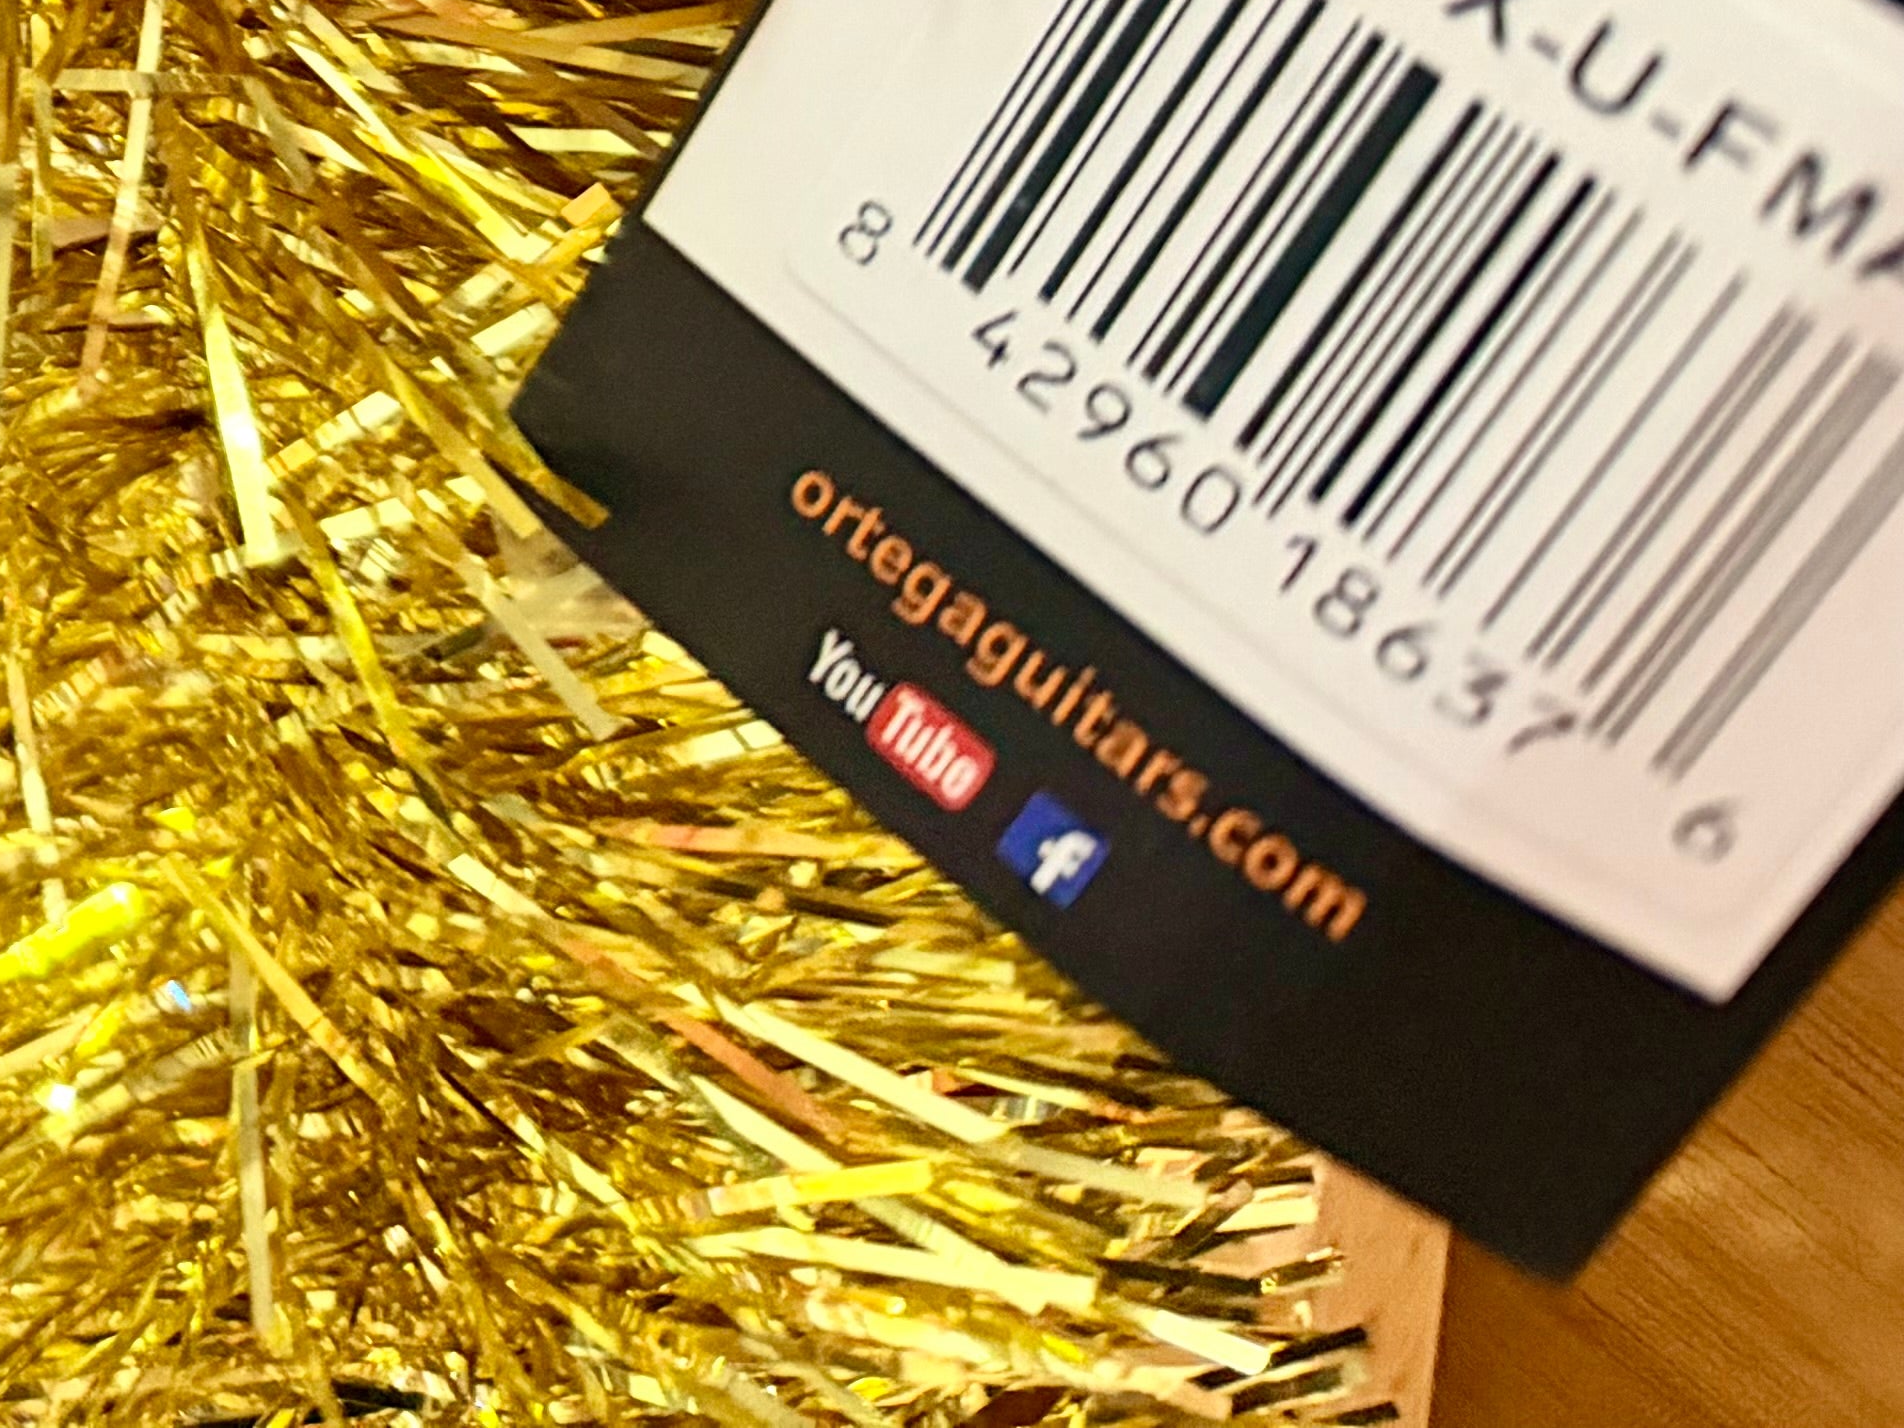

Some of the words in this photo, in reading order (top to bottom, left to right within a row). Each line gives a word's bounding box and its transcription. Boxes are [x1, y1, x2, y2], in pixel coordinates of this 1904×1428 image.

[791, 469, 1367, 942] ortegaguitars.com
[837, 200, 893, 266] 8
[970, 310, 1242, 535] 42960
[1280, 534, 1578, 758] 18637
[1670, 798, 1740, 864] 6
